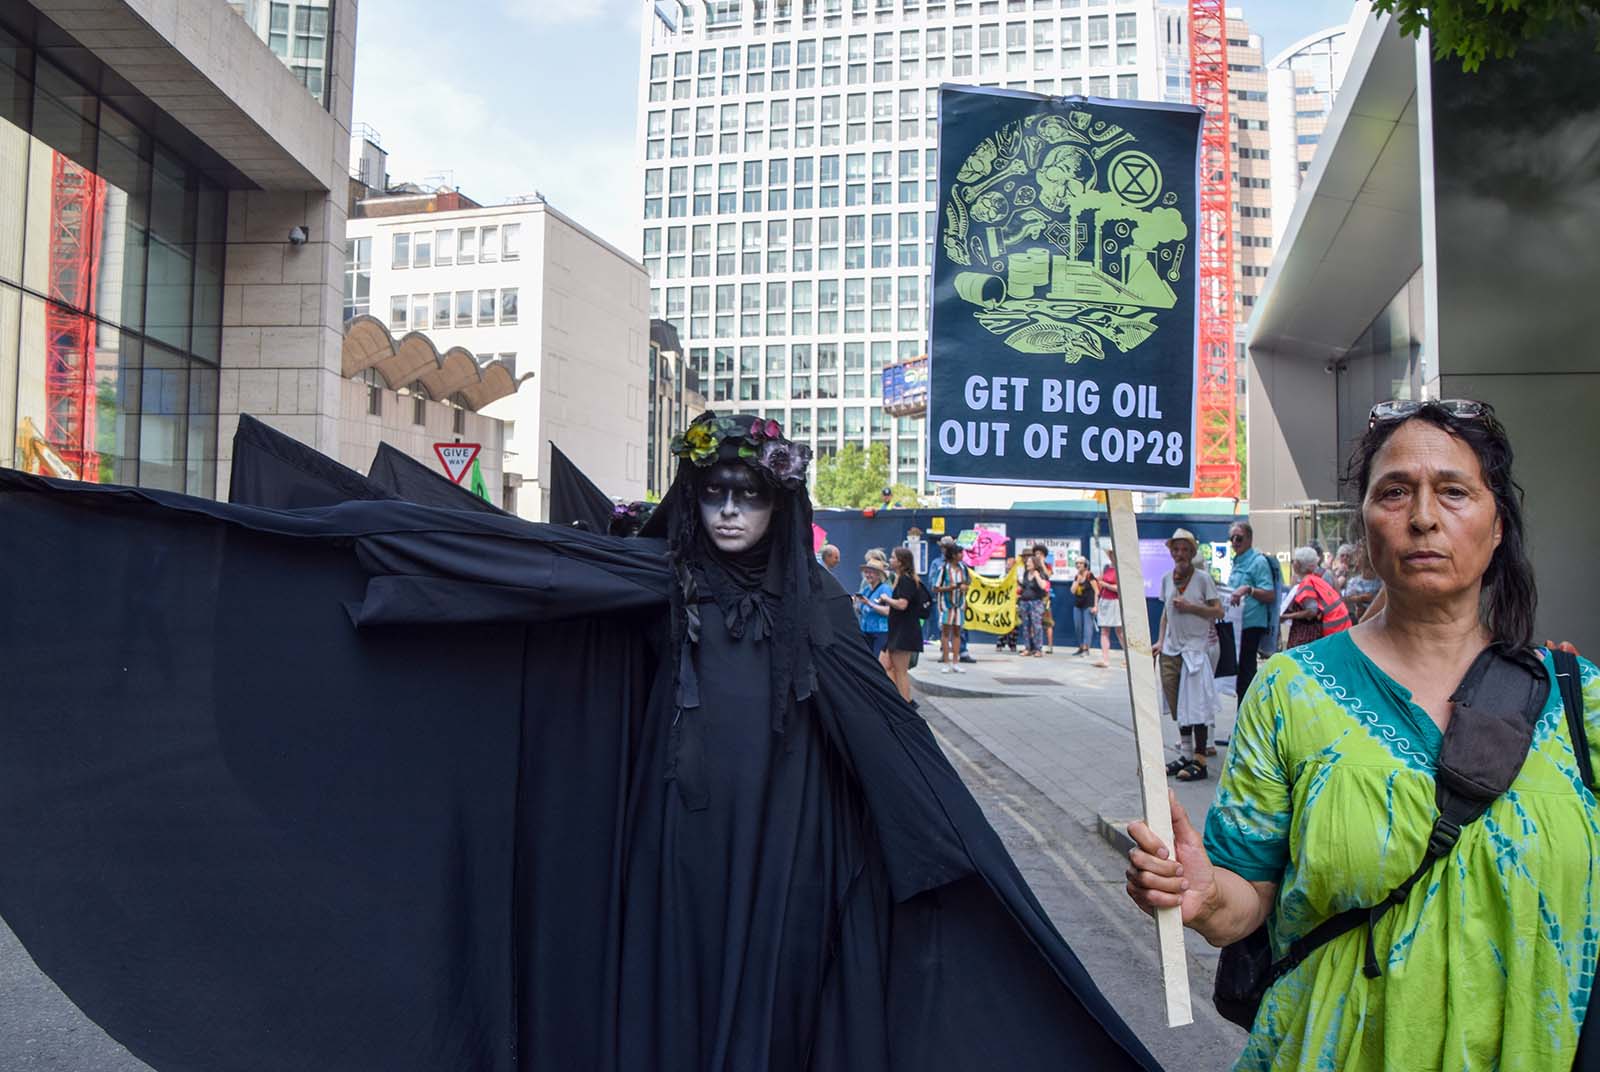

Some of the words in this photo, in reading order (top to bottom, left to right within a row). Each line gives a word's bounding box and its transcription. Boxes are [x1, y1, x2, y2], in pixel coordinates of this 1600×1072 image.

[964, 375, 1029, 411] GET
[1042, 378, 1100, 415] BIG
[1112, 382, 1162, 419] OIL
[443, 448, 469, 457] GIVE
[938, 419, 1010, 457] OUT
[1023, 423, 1068, 459] OF
[1081, 426, 1184, 466] COP28
